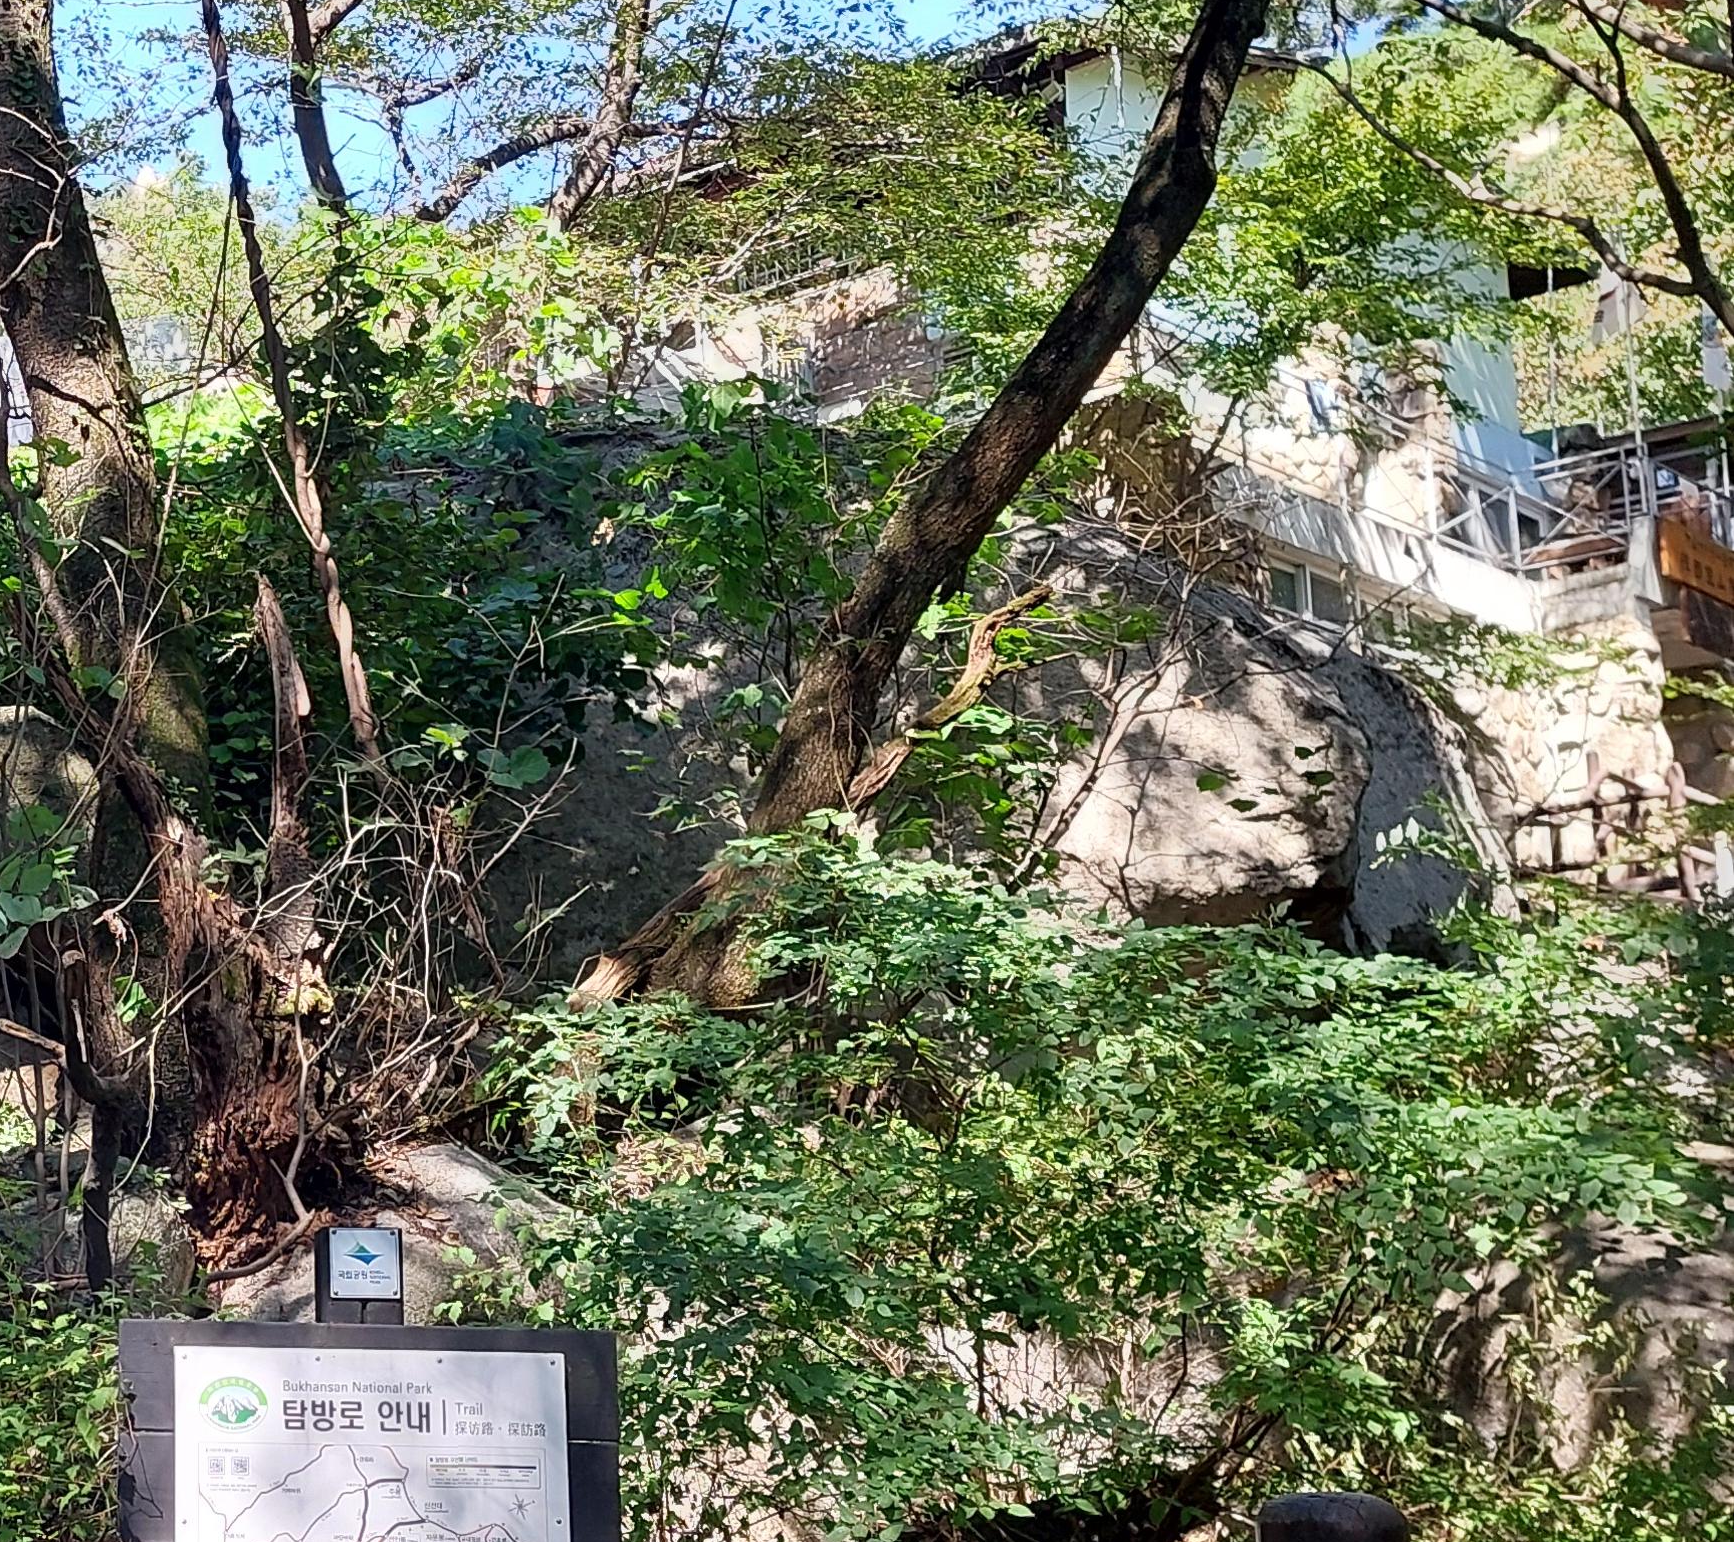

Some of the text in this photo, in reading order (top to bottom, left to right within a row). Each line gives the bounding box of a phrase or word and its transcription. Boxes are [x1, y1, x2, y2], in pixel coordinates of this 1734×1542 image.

[282, 1380, 433, 1395] Bukhansan National Park
[283, 1399, 366, 1433] 탐방로
[378, 1400, 432, 1434] 안내
[455, 1402, 483, 1416] Trail
